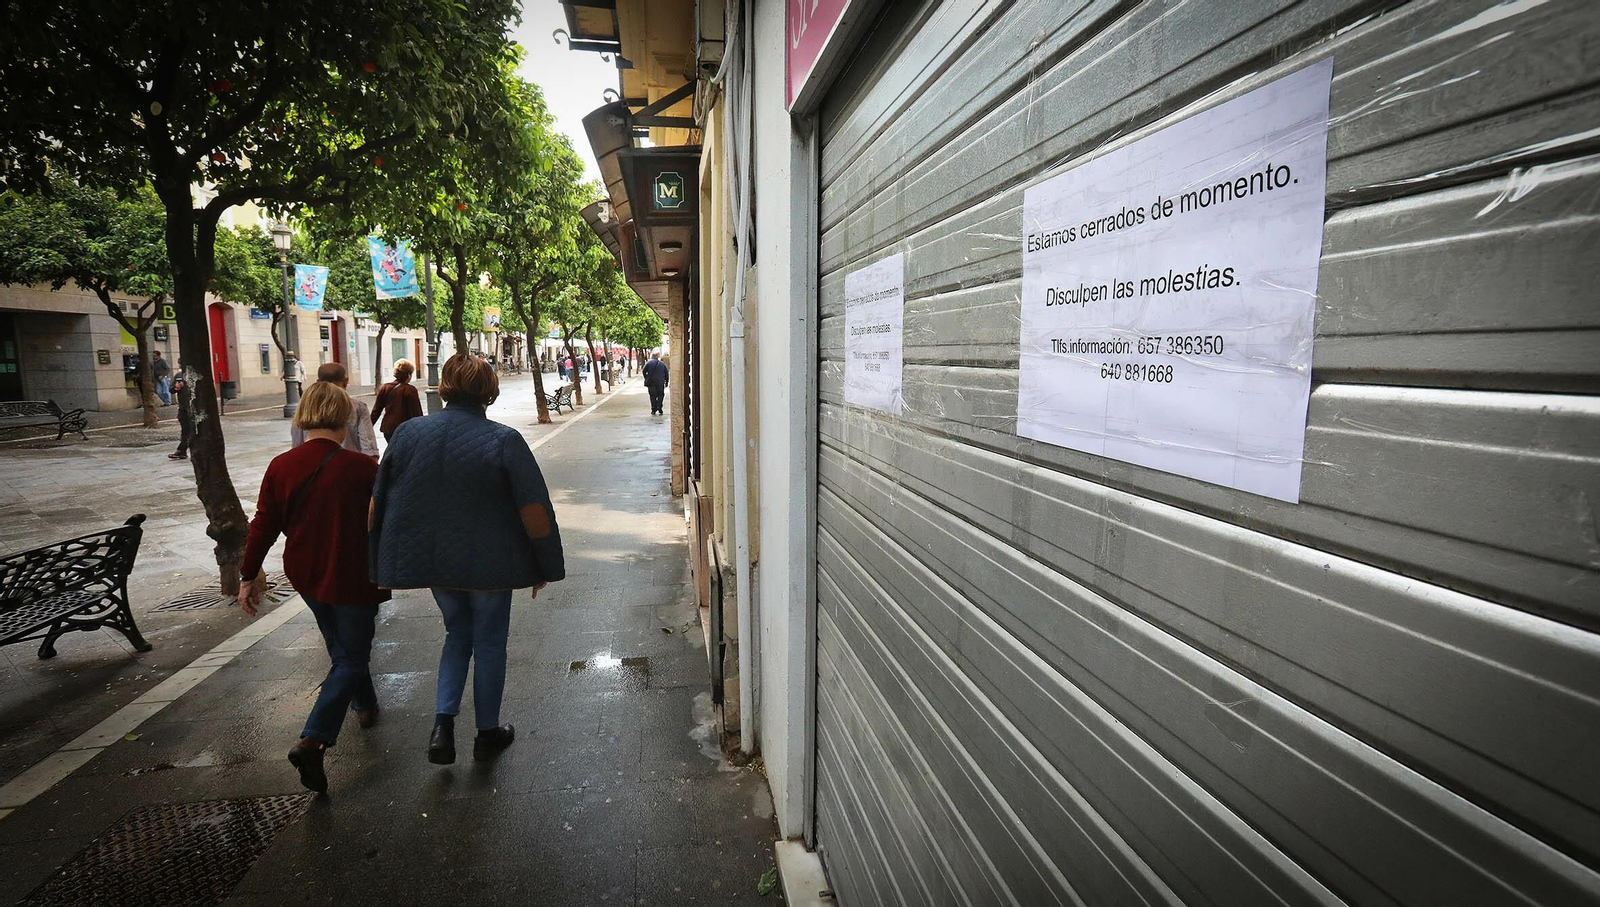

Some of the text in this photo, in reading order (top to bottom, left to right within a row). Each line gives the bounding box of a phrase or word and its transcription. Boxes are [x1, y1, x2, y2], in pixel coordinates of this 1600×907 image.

[659, 182, 678, 198] M
[1027, 162, 1299, 253] Estamos cerrados de momento.
[1046, 263, 1241, 308] Disculpen las molestias.
[1051, 335, 1224, 356] Tlfs.información: 657 386350
[1100, 362, 1174, 383] 640 881668
